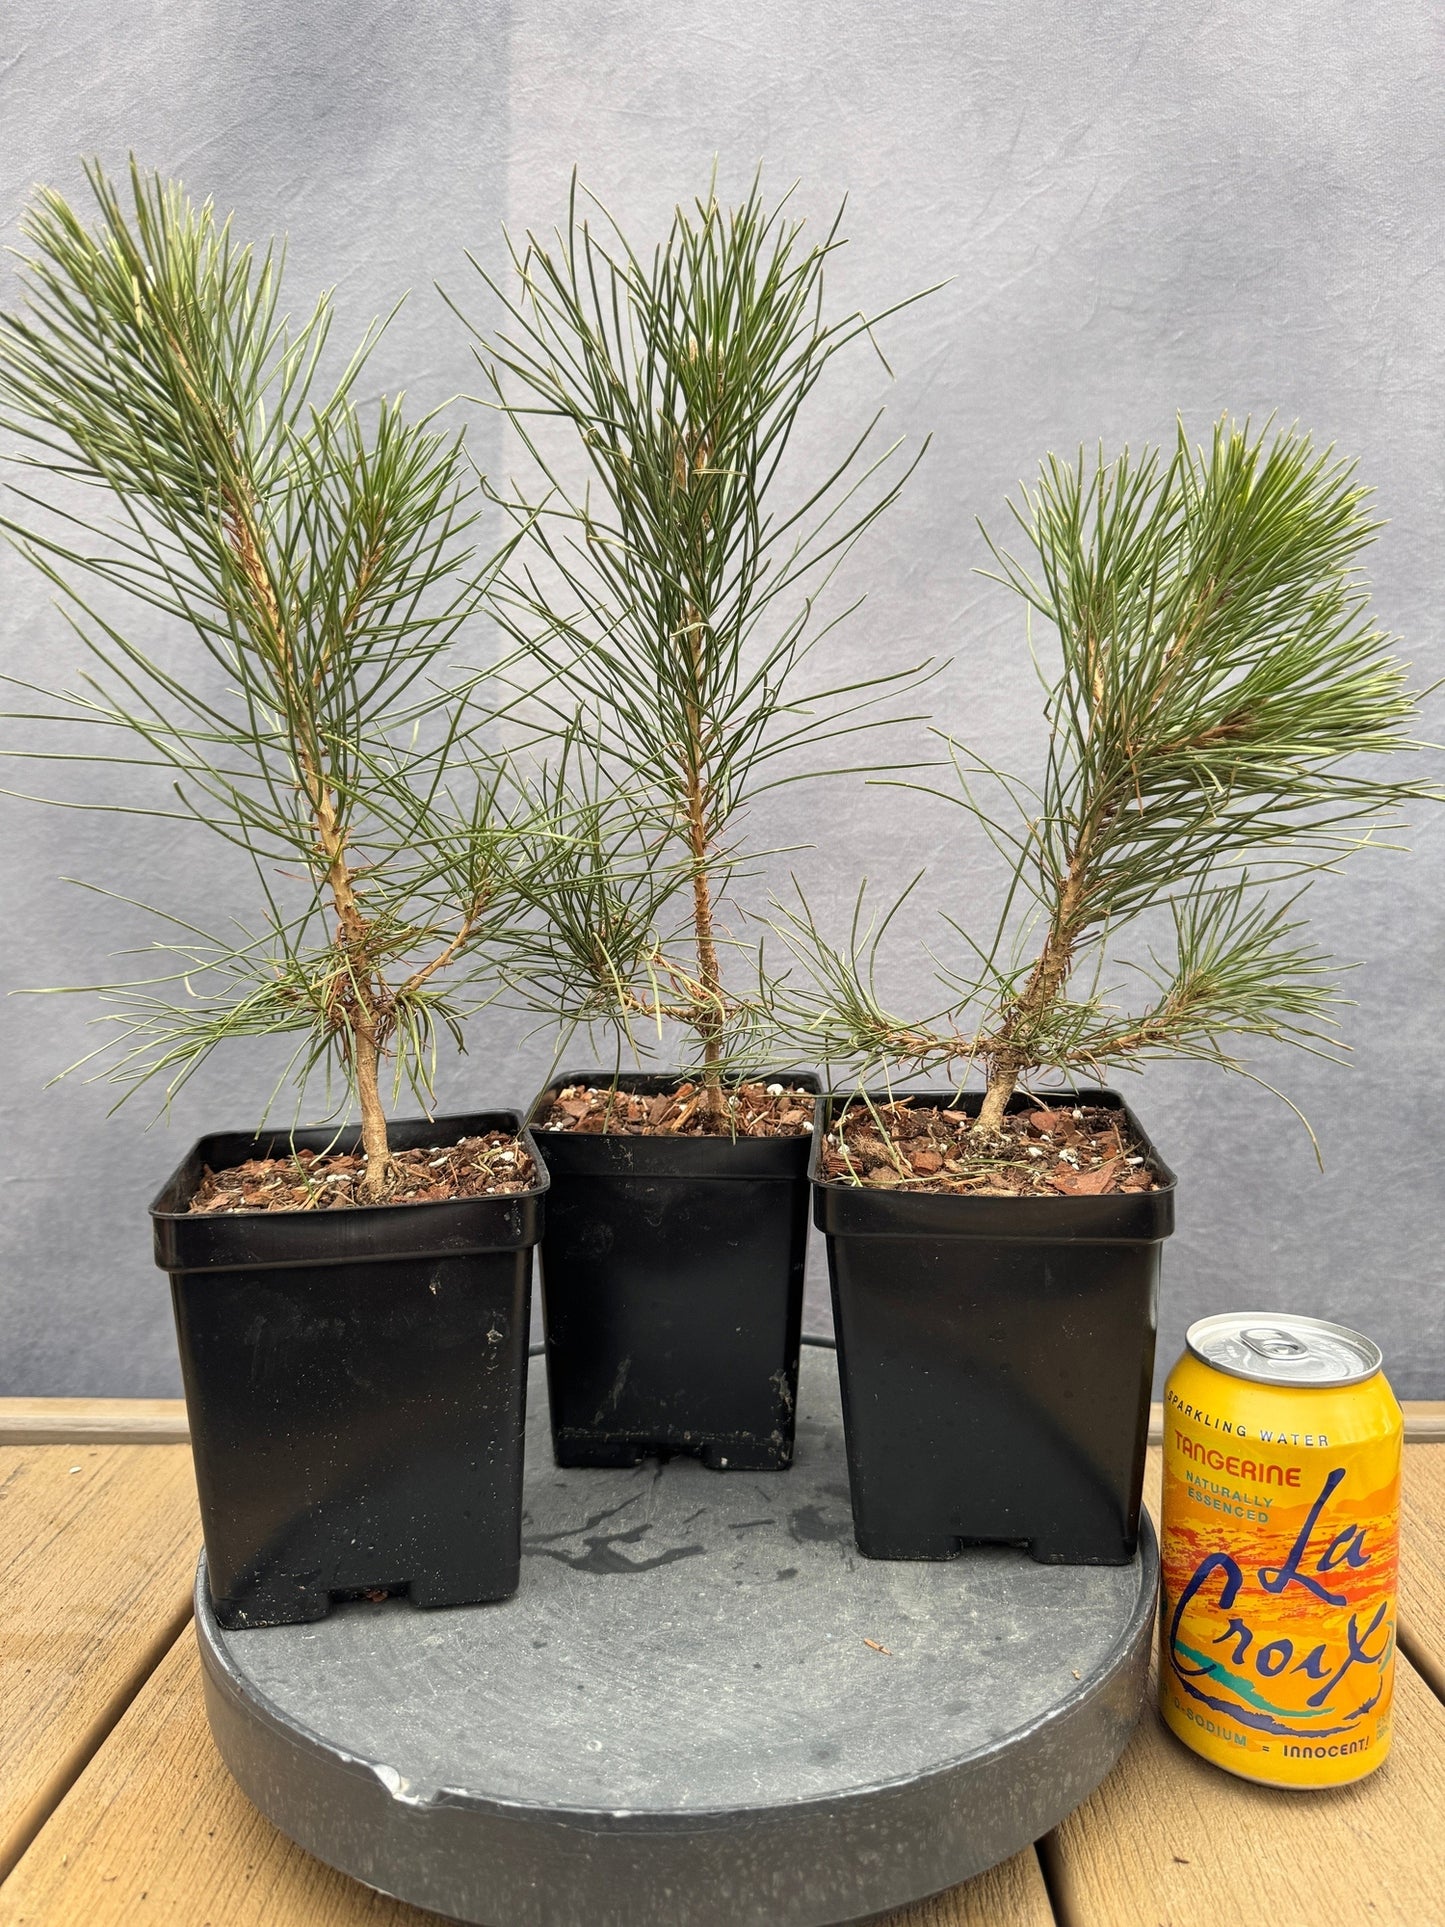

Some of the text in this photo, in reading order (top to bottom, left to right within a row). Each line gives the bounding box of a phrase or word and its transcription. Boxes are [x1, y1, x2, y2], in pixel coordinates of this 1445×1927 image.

[1167, 1390, 1329, 1446] SPARKLING WATER
[1174, 1429, 1302, 1487] TANGERINE
[1186, 1470, 1273, 1508] NATURALLY
[1188, 1488, 1270, 1523] ESSENCED
[1257, 1468, 1371, 1606] La
[1170, 1552, 1389, 1707] Croix
[1283, 1736, 1370, 1759] INNOCENT!
